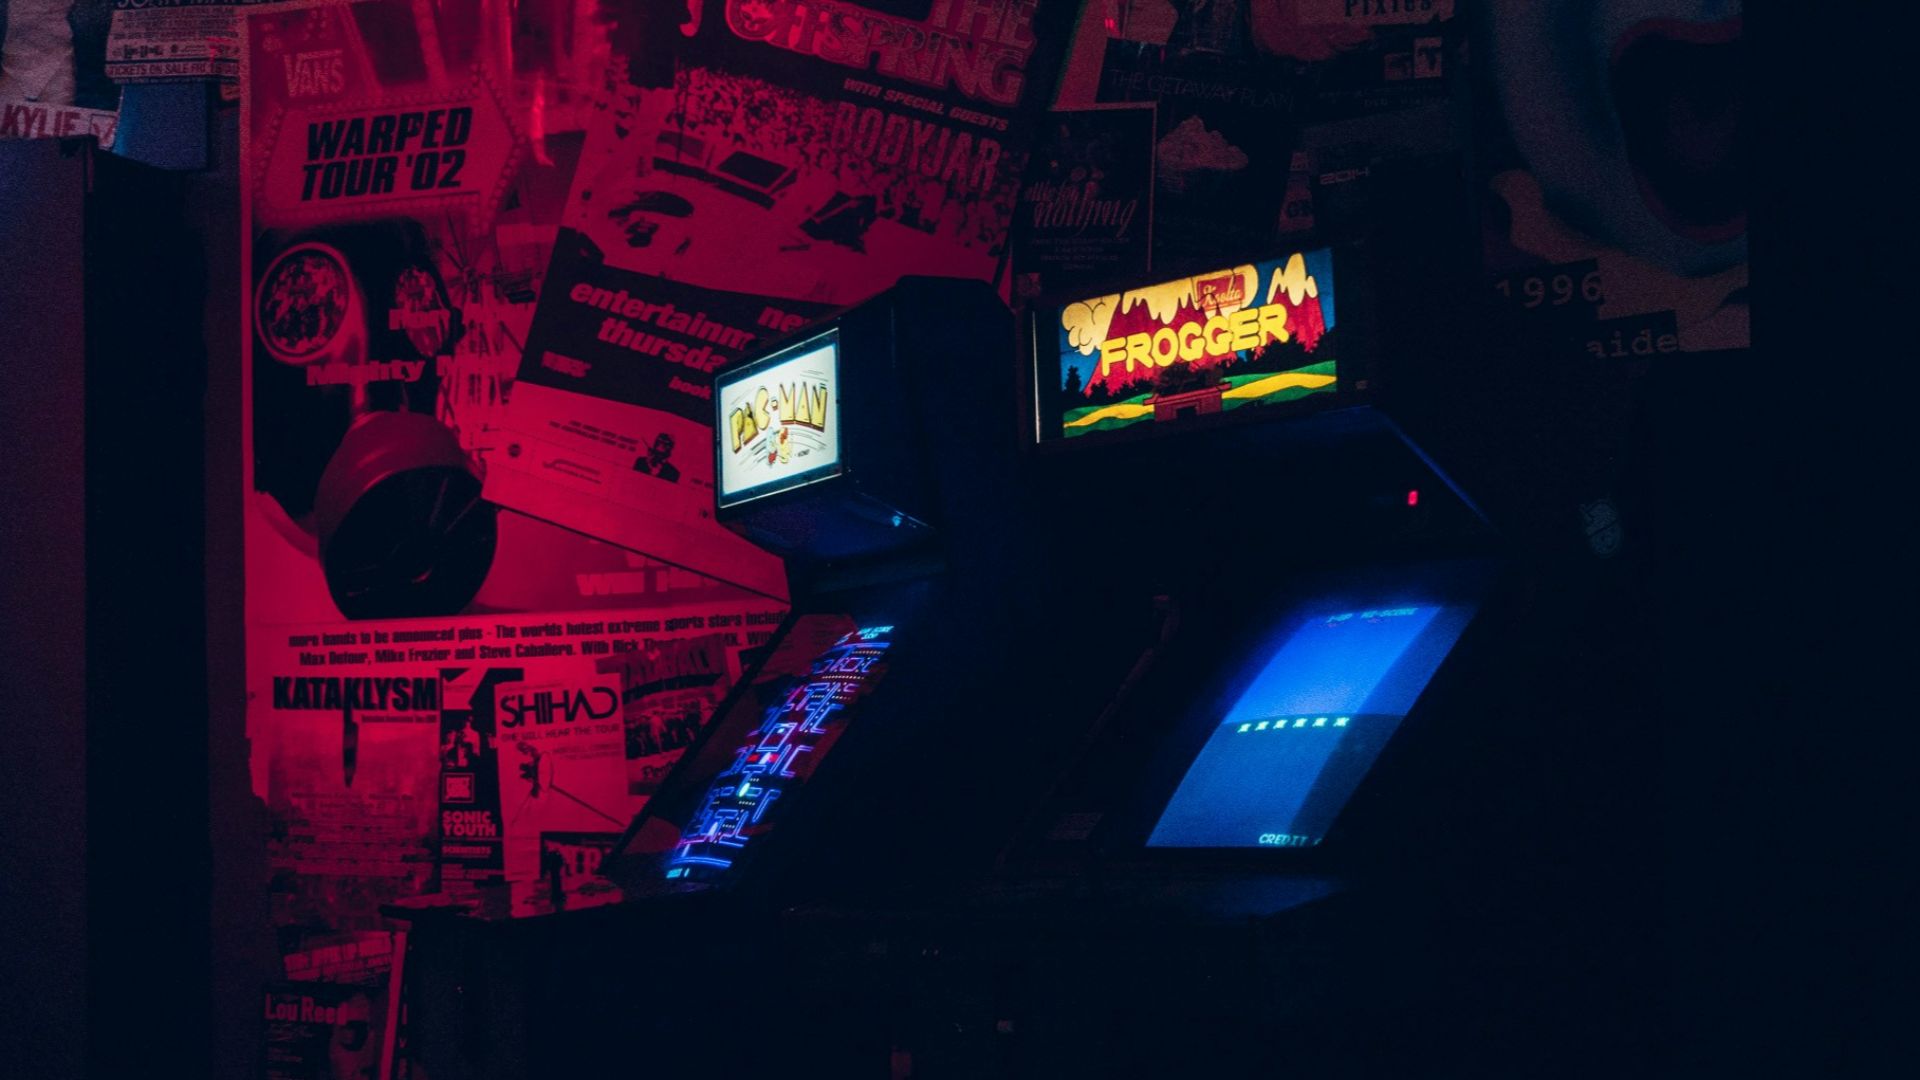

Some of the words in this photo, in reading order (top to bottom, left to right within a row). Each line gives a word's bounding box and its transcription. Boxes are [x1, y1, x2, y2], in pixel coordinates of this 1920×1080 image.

[283, 48, 344, 97] VANS
[844, 78, 882, 97] WITH
[883, 89, 945, 115] SPECIAL
[948, 106, 1009, 131] GUESTS
[307, 106, 472, 160] WARPED
[831, 101, 1001, 191] BODYJAR
[302, 157, 398, 200] TOUR
[405, 149, 467, 190] '02
[1494, 271, 1602, 309] 1996
[1100, 302, 1290, 377] FROGGER
[1585, 329, 1680, 359] aide
[728, 380, 828, 454] PAC-MAN
[496, 624, 517, 639] The
[374, 649, 406, 664] Mike
[479, 645, 513, 660] Steve
[273, 677, 438, 711] KATAKLYSM
[500, 686, 618, 728] SHIHAD
[443, 811, 491, 824] SONIC
[444, 823, 497, 837] YOUTH
[1258, 833, 1310, 847] CREDIT
